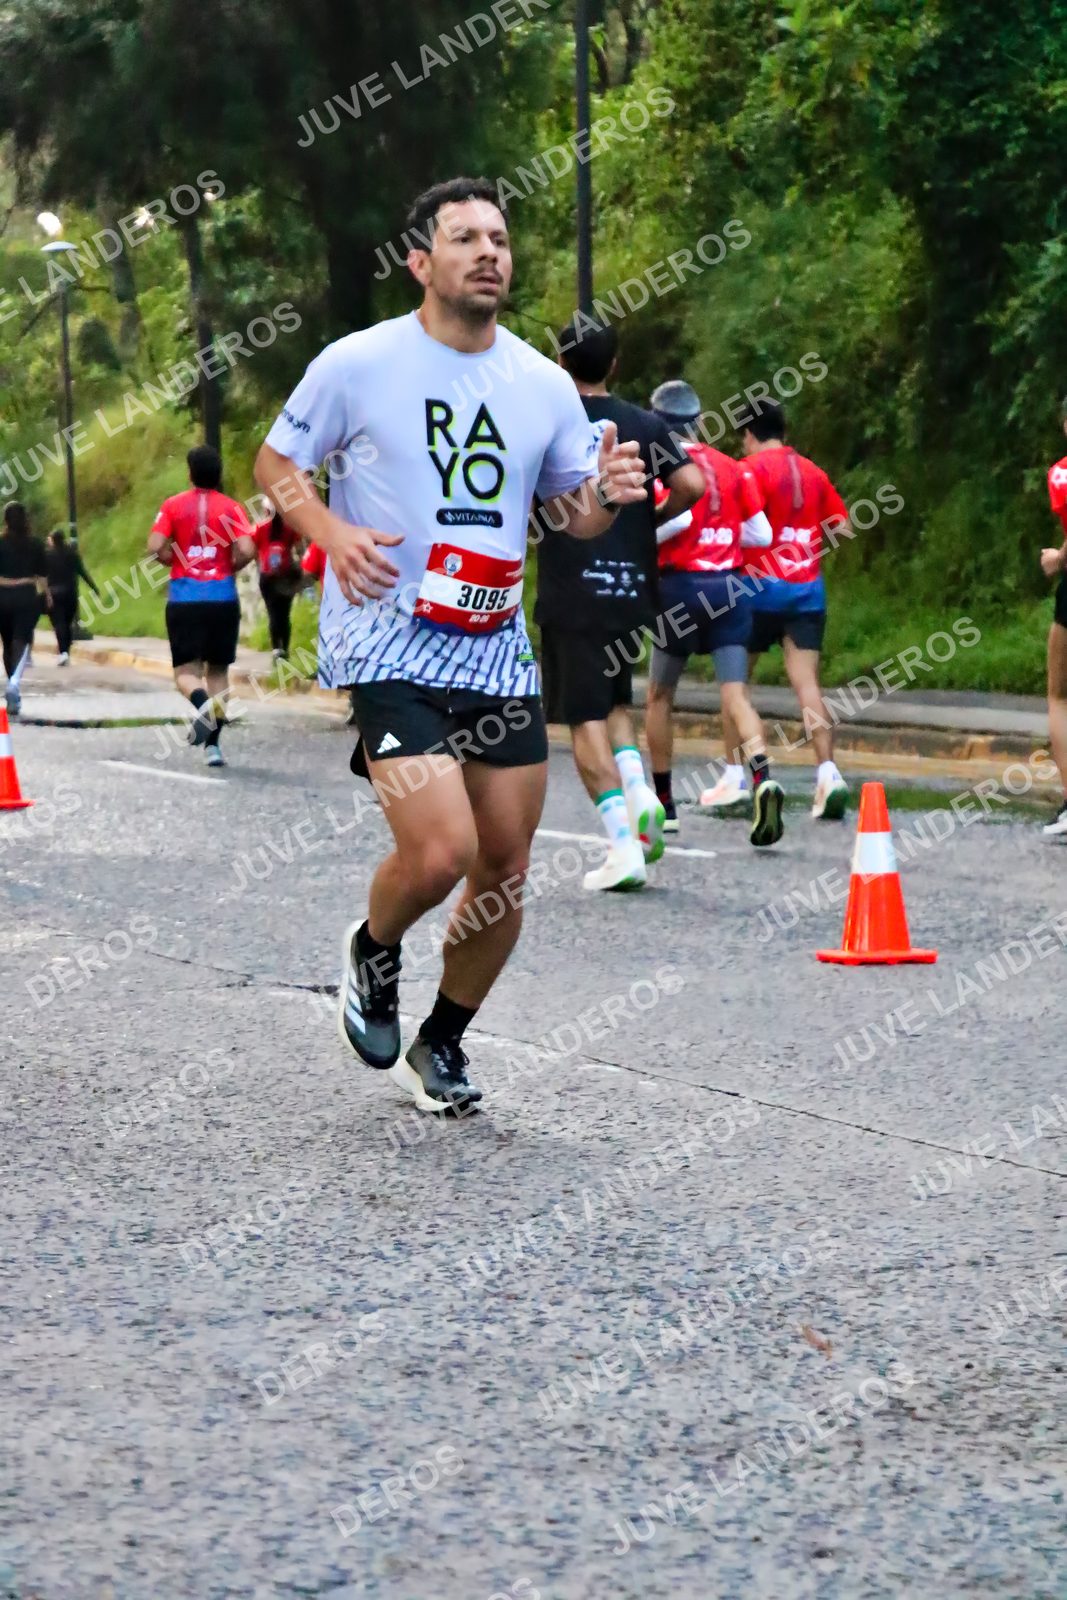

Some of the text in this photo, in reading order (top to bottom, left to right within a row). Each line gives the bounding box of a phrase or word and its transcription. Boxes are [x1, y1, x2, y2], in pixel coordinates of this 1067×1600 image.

[425, 398, 507, 452] RA
[428, 451, 505, 502] YO
[457, 584, 511, 611] 3095
